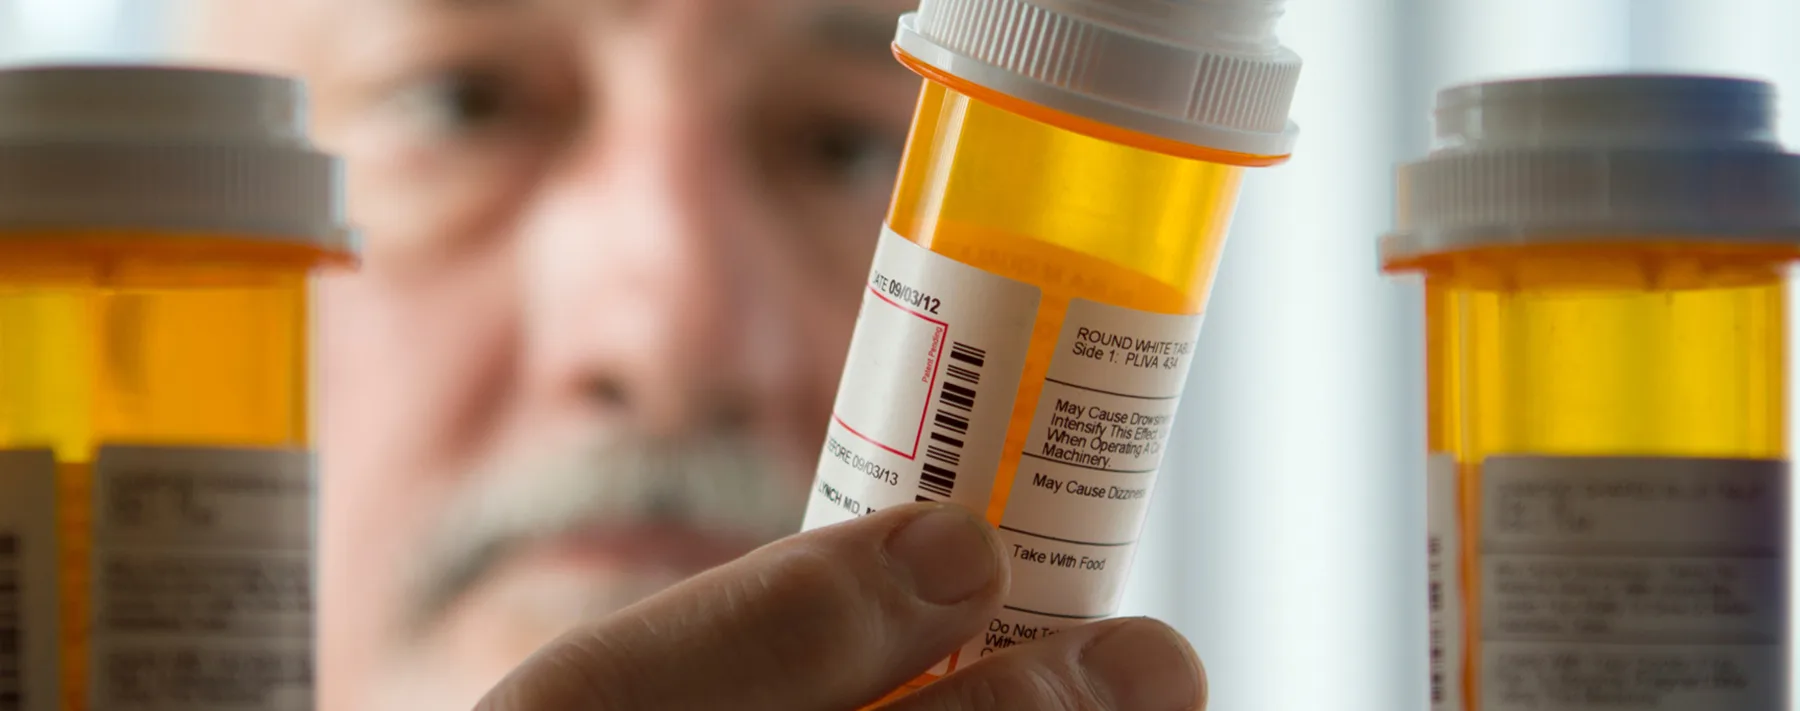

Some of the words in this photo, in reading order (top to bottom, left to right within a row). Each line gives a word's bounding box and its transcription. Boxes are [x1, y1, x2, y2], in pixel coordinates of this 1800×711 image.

[889, 279, 941, 315] 09/03/12
[921, 357, 934, 384] Patent
[928, 326, 943, 358] Pending
[1072, 341, 1105, 361] Side
[1108, 349, 1119, 364] 1:
[1125, 352, 1159, 369] PLIVA
[1076, 327, 1133, 350] ROUND
[1135, 339, 1173, 355] WHITE
[1055, 398, 1086, 420] May
[1088, 406, 1129, 424] Cause
[1050, 412, 1107, 438] Intensify
[1110, 424, 1134, 440] This
[1042, 442, 1111, 469] Machinery.
[1047, 426, 1087, 449] When
[1090, 436, 1142, 459] Operating
[1143, 441, 1151, 456] A
[852, 454, 899, 487] 09/03/13
[1032, 472, 1063, 495] May
[1065, 479, 1106, 499] Cause
[1013, 543, 1047, 564] Take
[1049, 551, 1077, 569] With
[1079, 556, 1106, 571] Food
[988, 618, 1010, 634] Do
[1012, 623, 1038, 640] Not
